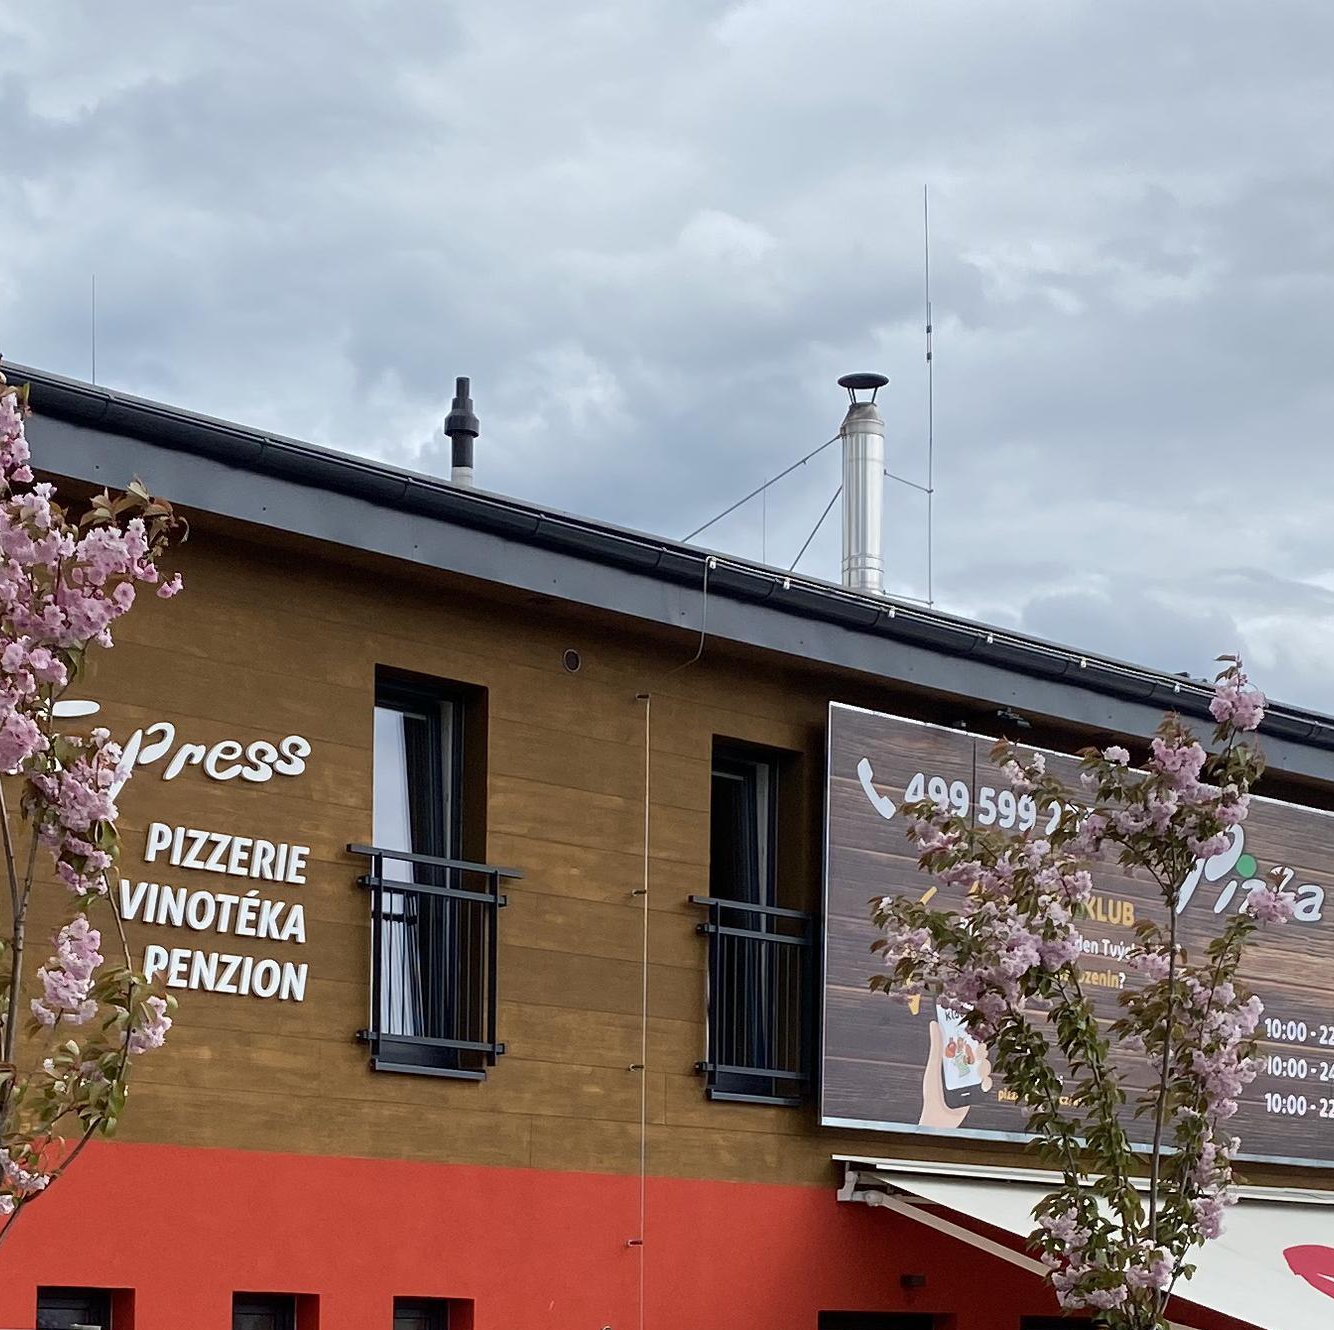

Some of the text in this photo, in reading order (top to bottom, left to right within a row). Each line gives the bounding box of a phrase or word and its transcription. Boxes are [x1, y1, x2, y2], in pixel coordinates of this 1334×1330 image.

[2, 699, 312, 806] press
[905, 772, 969, 818] 499
[978, 786, 1037, 833] 599
[144, 822, 311, 884] PIZZERIE
[119, 879, 307, 944] VINOTÉKA
[143, 944, 309, 1001] PENZION
[1101, 938, 1138, 962] Tvý
[1264, 1017, 1308, 1042] 10:00
[1266, 1055, 1308, 1079] 10:00
[1264, 1092, 1308, 1116] 10:00
